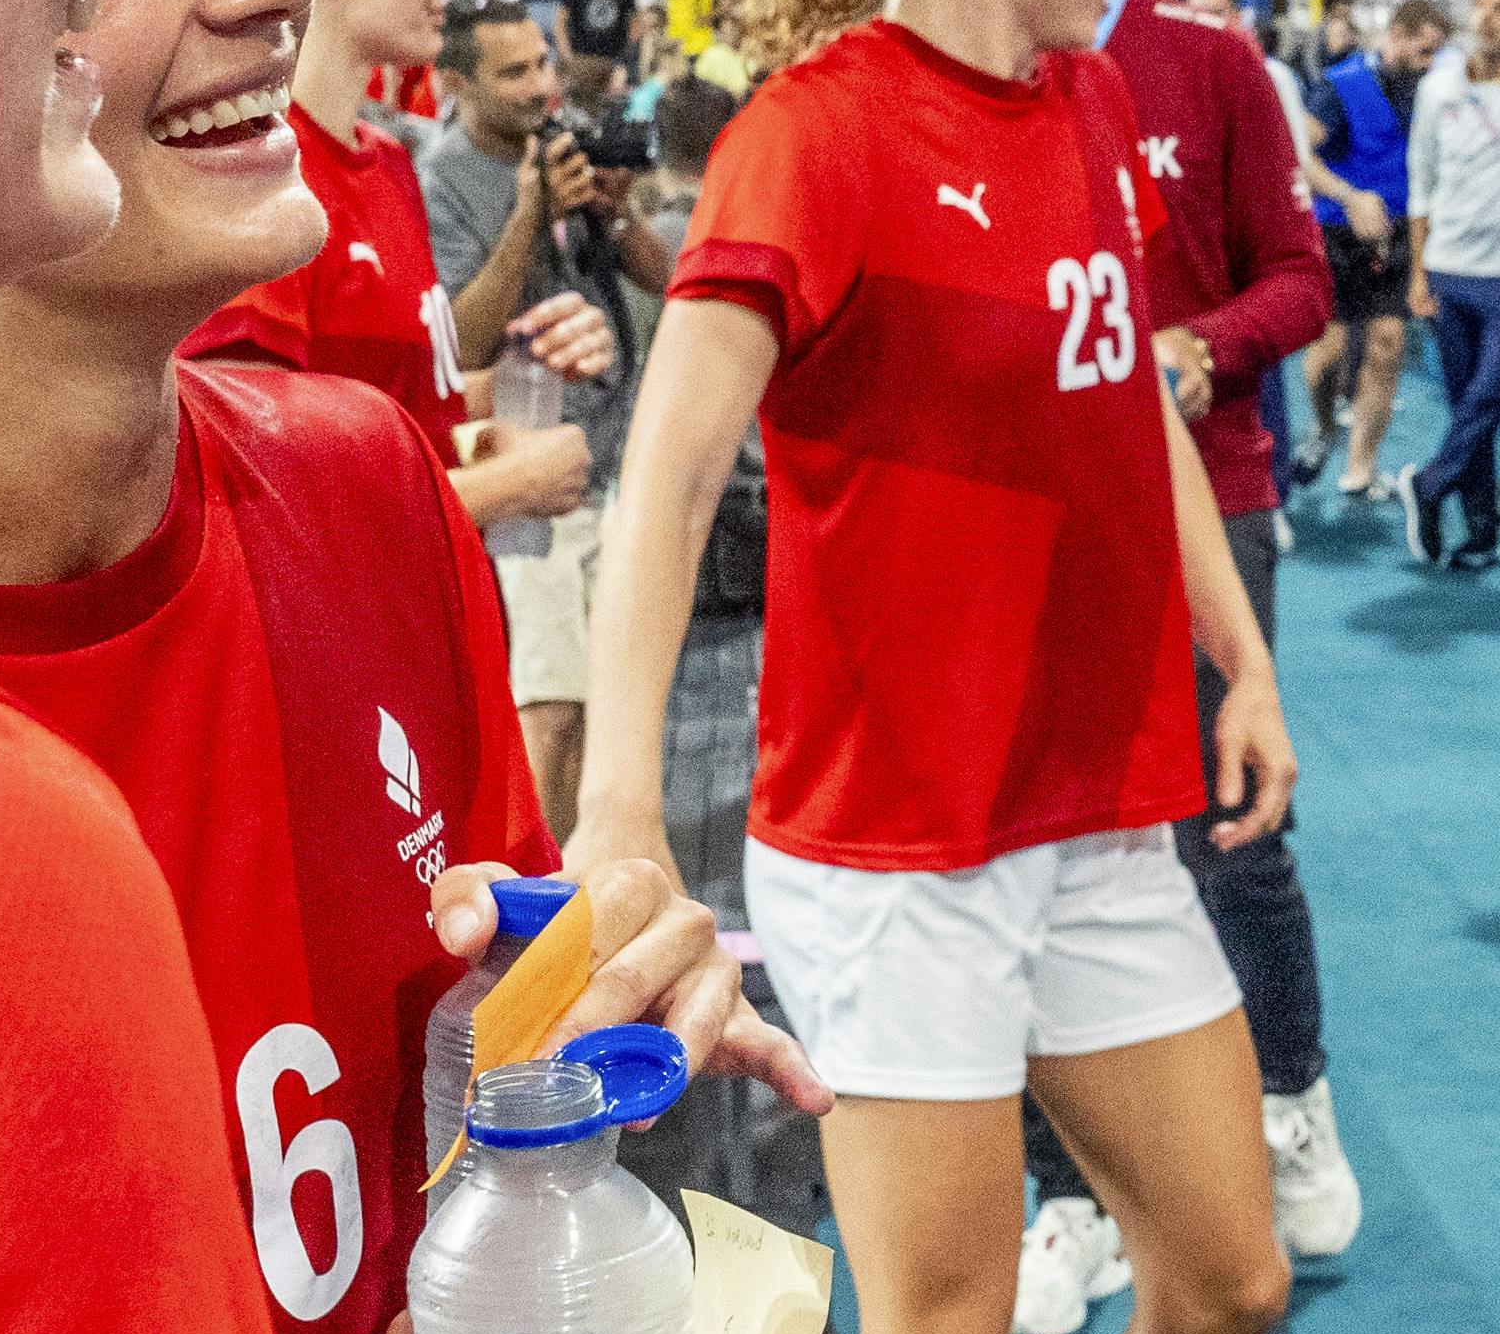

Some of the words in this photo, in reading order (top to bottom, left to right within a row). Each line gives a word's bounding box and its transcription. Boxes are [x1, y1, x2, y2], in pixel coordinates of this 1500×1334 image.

[1046, 250, 1136, 391] 23
[396, 810, 445, 862] DENMARK
[235, 1022, 364, 1322] 6
